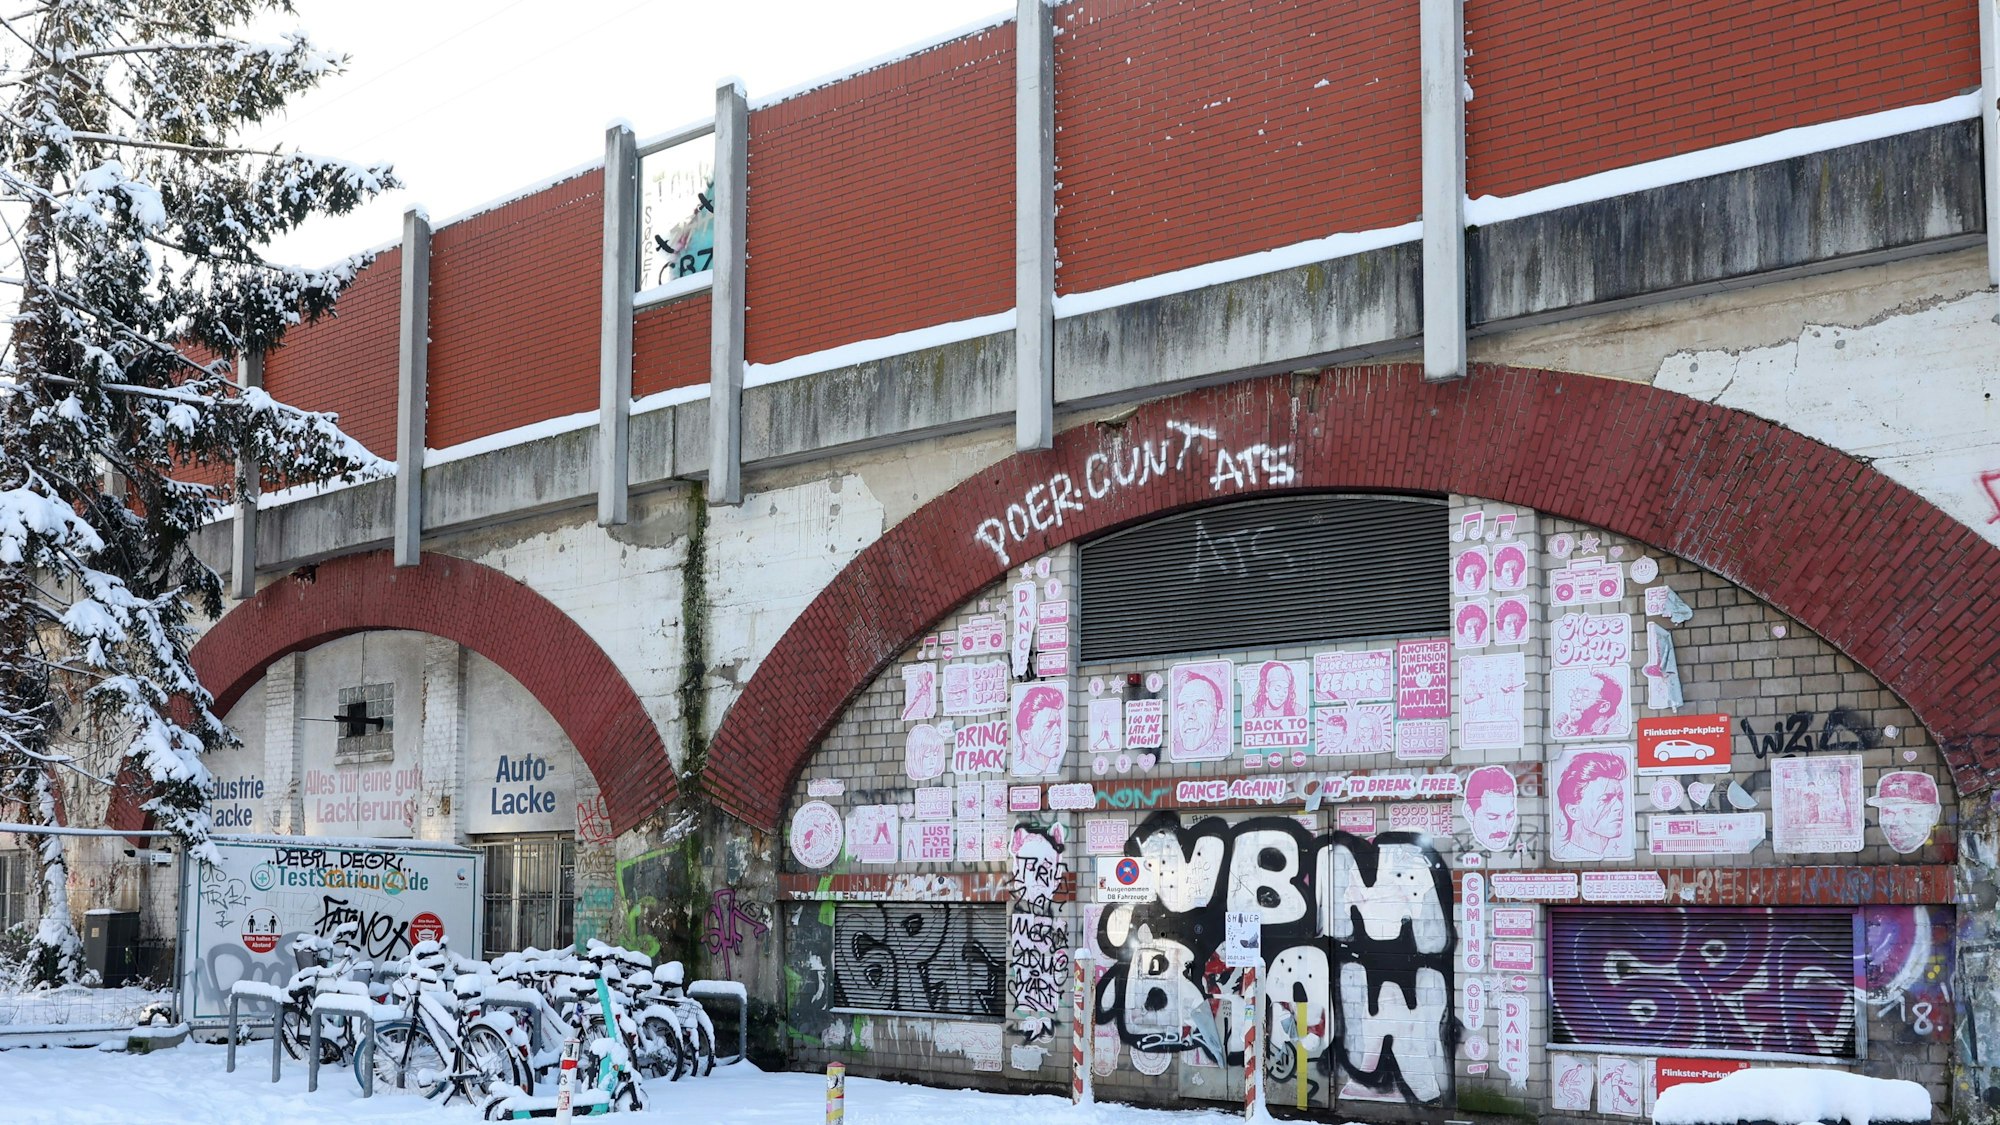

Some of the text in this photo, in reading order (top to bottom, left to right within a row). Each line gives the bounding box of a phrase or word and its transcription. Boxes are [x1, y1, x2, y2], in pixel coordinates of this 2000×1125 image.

[1558, 614, 1624, 646] Move
[1401, 643, 1446, 654] ANOTHER
[1401, 653, 1446, 664] DIMENSION
[1401, 663, 1446, 676] ANOTHER
[973, 678, 1006, 692] GIVE
[1320, 668, 1385, 693] BEATS
[1401, 675, 1446, 689] DIMION
[1401, 689, 1446, 706] ANOTHER
[1133, 715, 1142, 724] GO
[1145, 714, 1160, 723] OUT
[1244, 718, 1308, 732] BACK TO
[957, 722, 1007, 748] BRING
[1128, 724, 1159, 735] LATE AT
[1401, 726, 1444, 737] OUTER
[1643, 725, 1725, 736] Flinkster-Parkplatz
[1128, 734, 1161, 746] NIGHT
[1245, 733, 1306, 746] REALITY
[1401, 738, 1444, 748] SPACE
[956, 749, 1004, 771] IT BACK
[496, 753, 555, 783] Auto-
[212, 774, 264, 800] dustrie
[304, 769, 335, 796] Alles
[340, 767, 358, 793] für
[362, 768, 392, 793] eine
[1350, 780, 1365, 792] TO
[1368, 779, 1411, 792] BREAK
[1421, 778, 1460, 791] FREE.
[920, 791, 949, 800] OUTER
[1180, 781, 1284, 800] DANCE AGAIN!
[491, 785, 556, 815] Lacke
[316, 796, 415, 828] Lackierung
[920, 802, 949, 811] SPACE
[1391, 804, 1453, 816] GOOD LIFE
[1391, 815, 1453, 825] GOOD LIFE
[922, 826, 950, 836] LUST
[1090, 825, 1124, 834] OUTER
[922, 837, 950, 847] FOR
[1090, 834, 1124, 844] SPACE
[922, 848, 950, 858] LIFE
[1465, 857, 1479, 865] I'M
[1106, 886, 1149, 894] Ausgenommen
[1496, 883, 1575, 896] TOGETHER
[1585, 883, 1664, 894] CELEBRATE
[1466, 877, 1481, 968] COMING
[1467, 983, 1481, 1028] OUT
